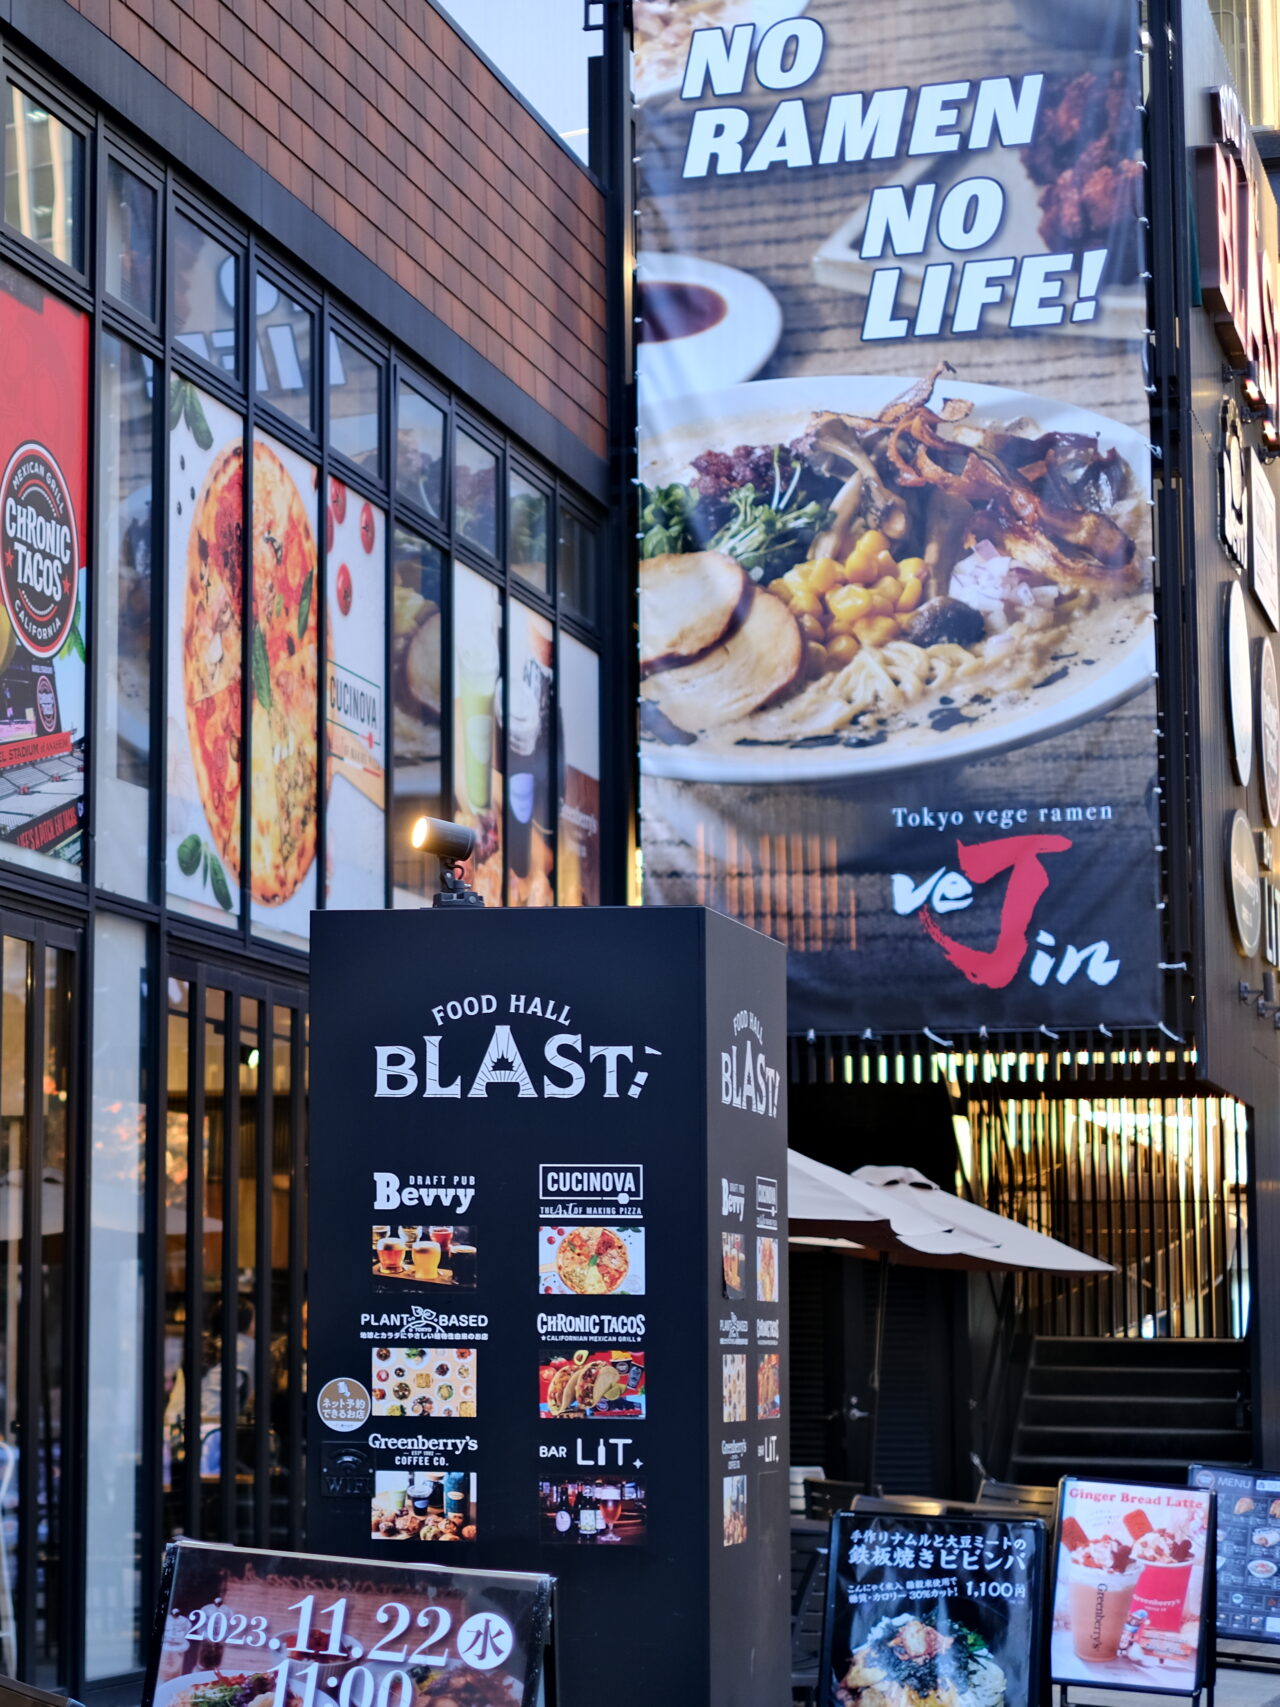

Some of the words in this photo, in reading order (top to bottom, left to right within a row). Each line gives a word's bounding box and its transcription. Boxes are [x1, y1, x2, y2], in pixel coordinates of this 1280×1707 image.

[681, 16, 823, 98] NO
[682, 74, 1045, 178] RAMEN
[860, 177, 1004, 258] NO
[860, 249, 1108, 340] LIFE!
[12, 461, 45, 491] MEXICAN
[45, 471, 64, 515] GRILL
[5, 497, 71, 565] CHRONIC
[13, 541, 63, 602] TACOS
[14, 599, 62, 640] CALIFORNIA
[329, 675, 378, 730] CUCINOVA
[892, 806, 964, 832] Tokyo
[973, 808, 1028, 829] vege
[1039, 805, 1113, 822] ramen
[431, 994, 498, 1027] FOOD
[509, 993, 571, 1026] HALL
[733, 1009, 748, 1037] FOOD
[373, 1025, 662, 1099] BLAST!
[721, 1040, 780, 1119] BLAST!
[373, 1171, 476, 1215] Bevvy
[409, 1175, 447, 1186] DRAFT
[453, 1175, 476, 1186] PUB
[546, 1171, 636, 1192] CUCINOVA
[540, 1206, 554, 1215] THE
[573, 1206, 583, 1215] OF
[586, 1207, 617, 1215] MAKING
[619, 1207, 642, 1215] PIZZA
[360, 1313, 410, 1326] PLANT
[438, 1314, 489, 1327] BASED
[536, 1312, 600, 1334] CHRONIC
[600, 1313, 646, 1336] TACOS
[322, 1397, 366, 1409] ネット予約
[322, 1409, 366, 1419] できるお店
[368, 1432, 479, 1455] Greenberry's
[539, 1445, 567, 1458] BAR
[394, 1456, 430, 1466] COFFEE
[433, 1456, 449, 1466] CO.
[1217, 1476, 1252, 1489] MENU
[1069, 1487, 1116, 1502] Ginger
[1120, 1492, 1162, 1506] Bread
[1166, 1496, 1203, 1510] Latte
[849, 1529, 1027, 1551] 手作りナムルと大豆ミートの
[848, 1545, 1027, 1571] 鉄板焼きビビンバ
[267, 1657, 414, 1707] 11:00
